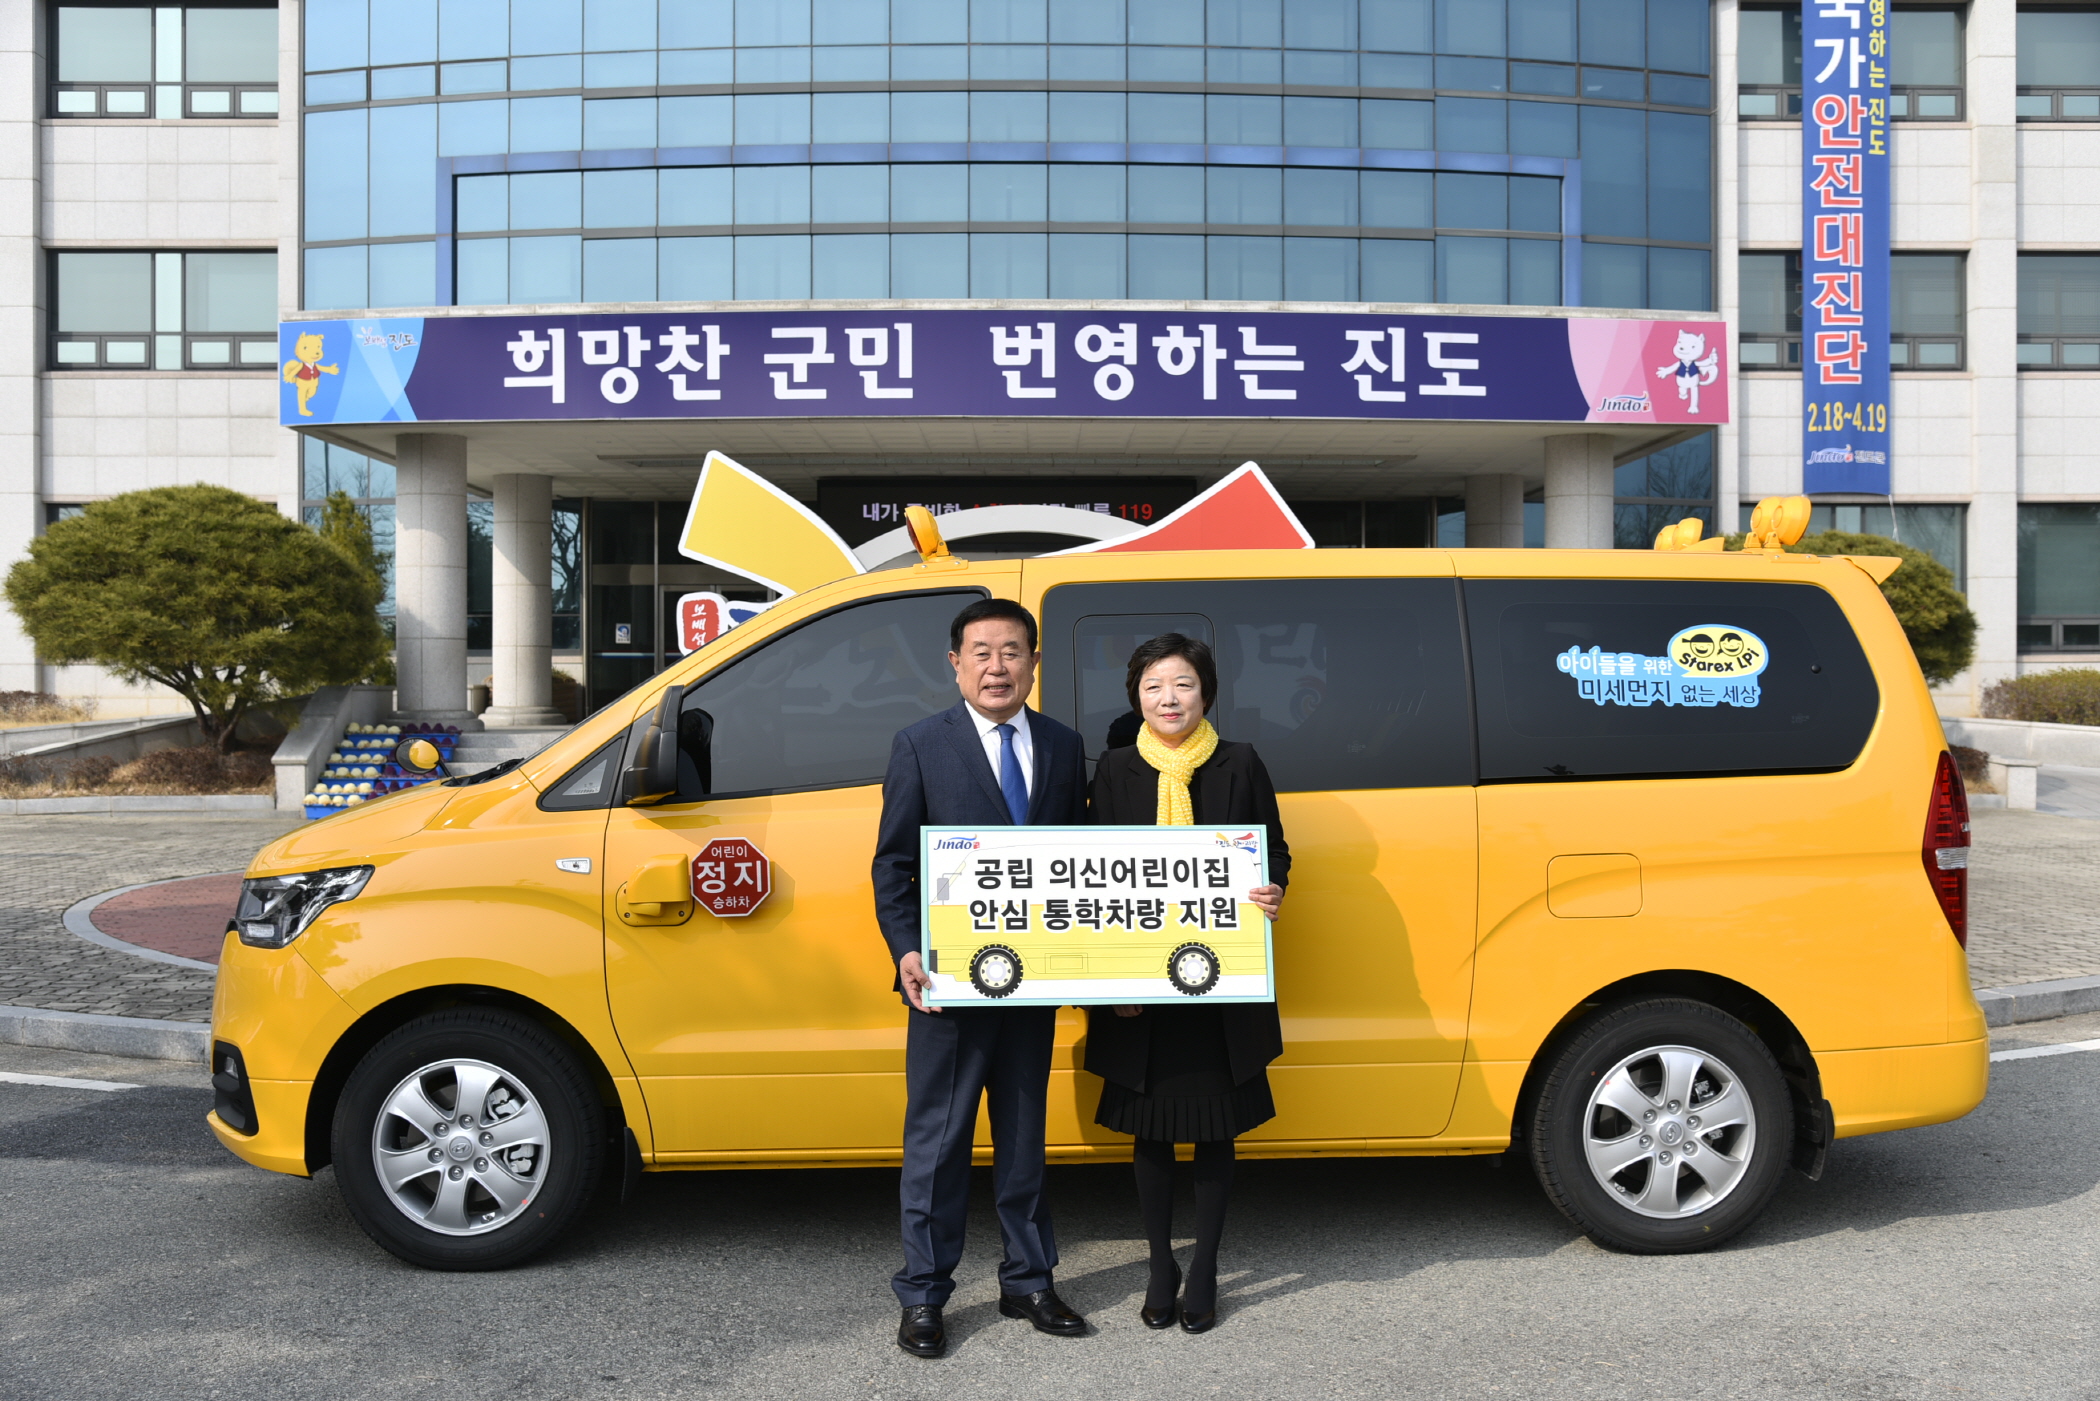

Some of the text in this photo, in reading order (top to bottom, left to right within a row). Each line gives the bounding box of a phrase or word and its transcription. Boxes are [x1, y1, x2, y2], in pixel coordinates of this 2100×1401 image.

[1868, 98, 1886, 156] 진도
[503, 322, 1487, 404] 희망찬 군민 번영하는 진도
[1597, 397, 1642, 412] Jindo
[1808, 402, 1887, 433] 2.18~4.19
[862, 502, 900, 522] 내가
[1118, 503, 1153, 520] 119
[1559, 649, 1673, 676] 아이들을 위한
[1679, 647, 1760, 673] Starex LPi
[1581, 678, 1757, 703] 미세먼지 없는 세상
[711, 845, 748, 858] 어린이
[933, 839, 973, 851] Jindo
[696, 860, 762, 894] 정지
[974, 856, 1231, 890] 공립 의신어린이집
[712, 896, 751, 909] 승하차
[969, 896, 1238, 931] 안심 통학차량 지원
